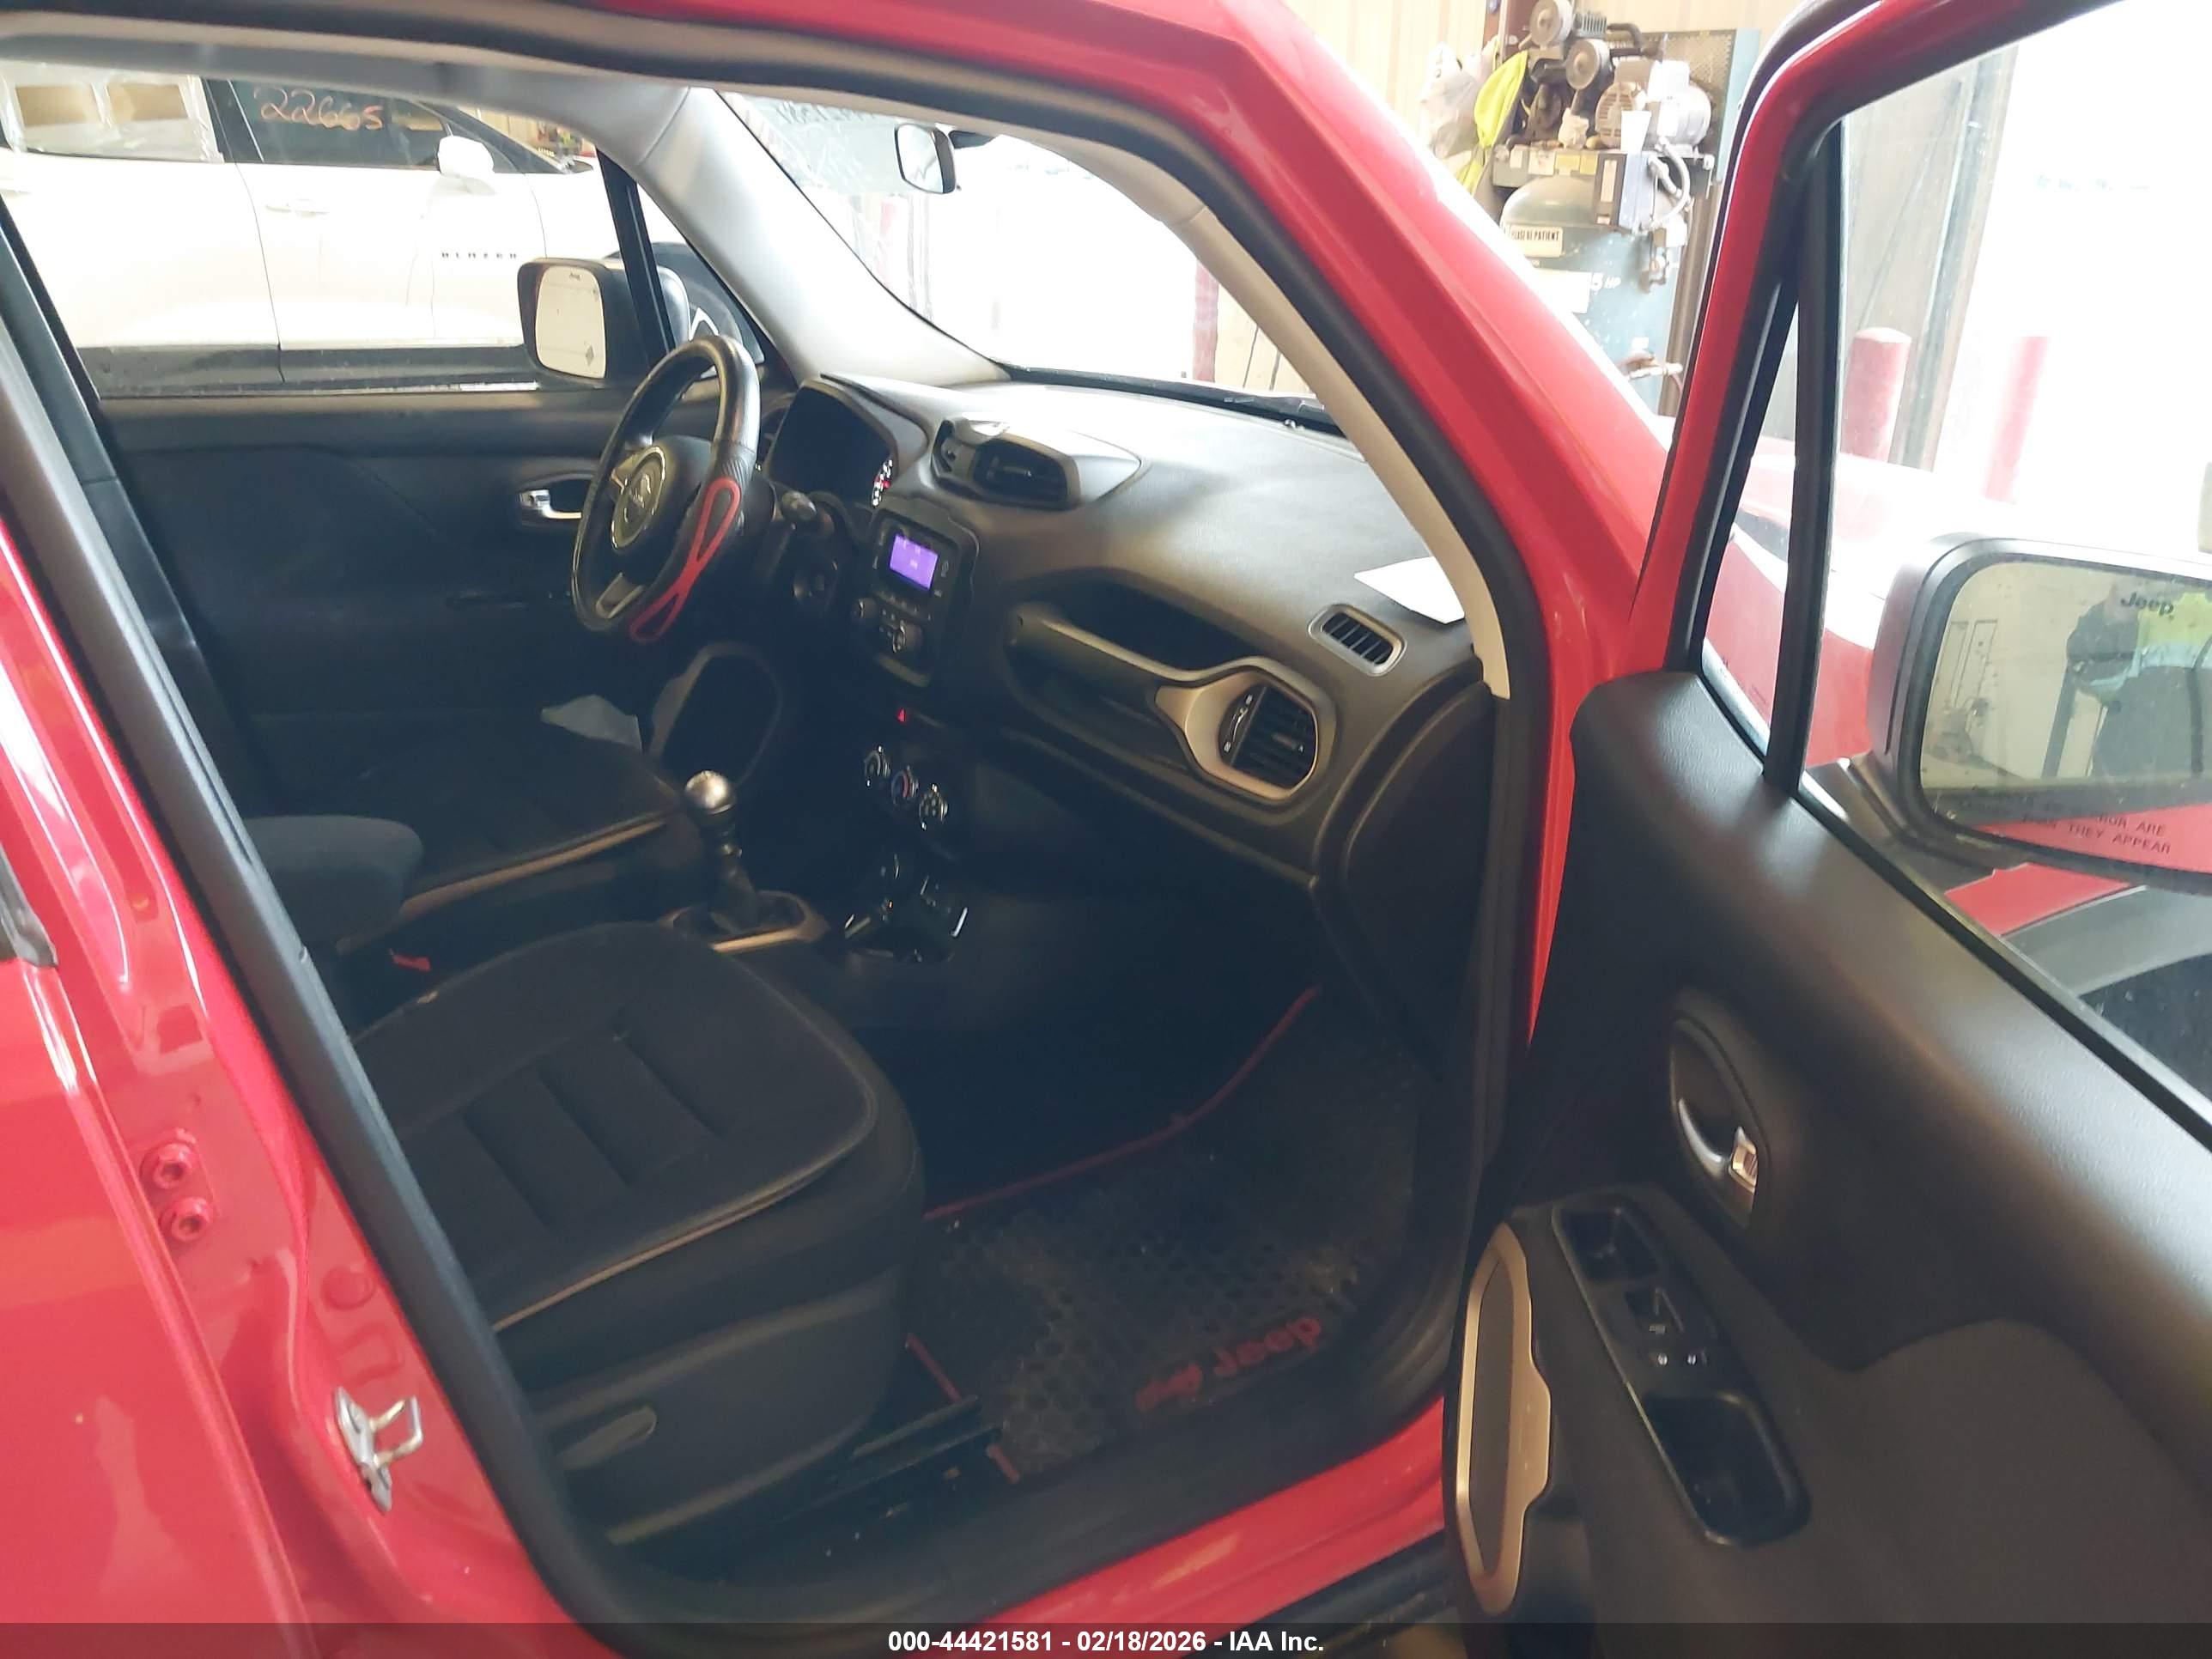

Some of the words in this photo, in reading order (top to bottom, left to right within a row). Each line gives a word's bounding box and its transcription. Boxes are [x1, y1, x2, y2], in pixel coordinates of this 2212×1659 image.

[1534, 230, 1560, 241] PATIENT
[2120, 592, 2174, 617] Jeep
[1212, 1316, 1323, 1378] Jeep
